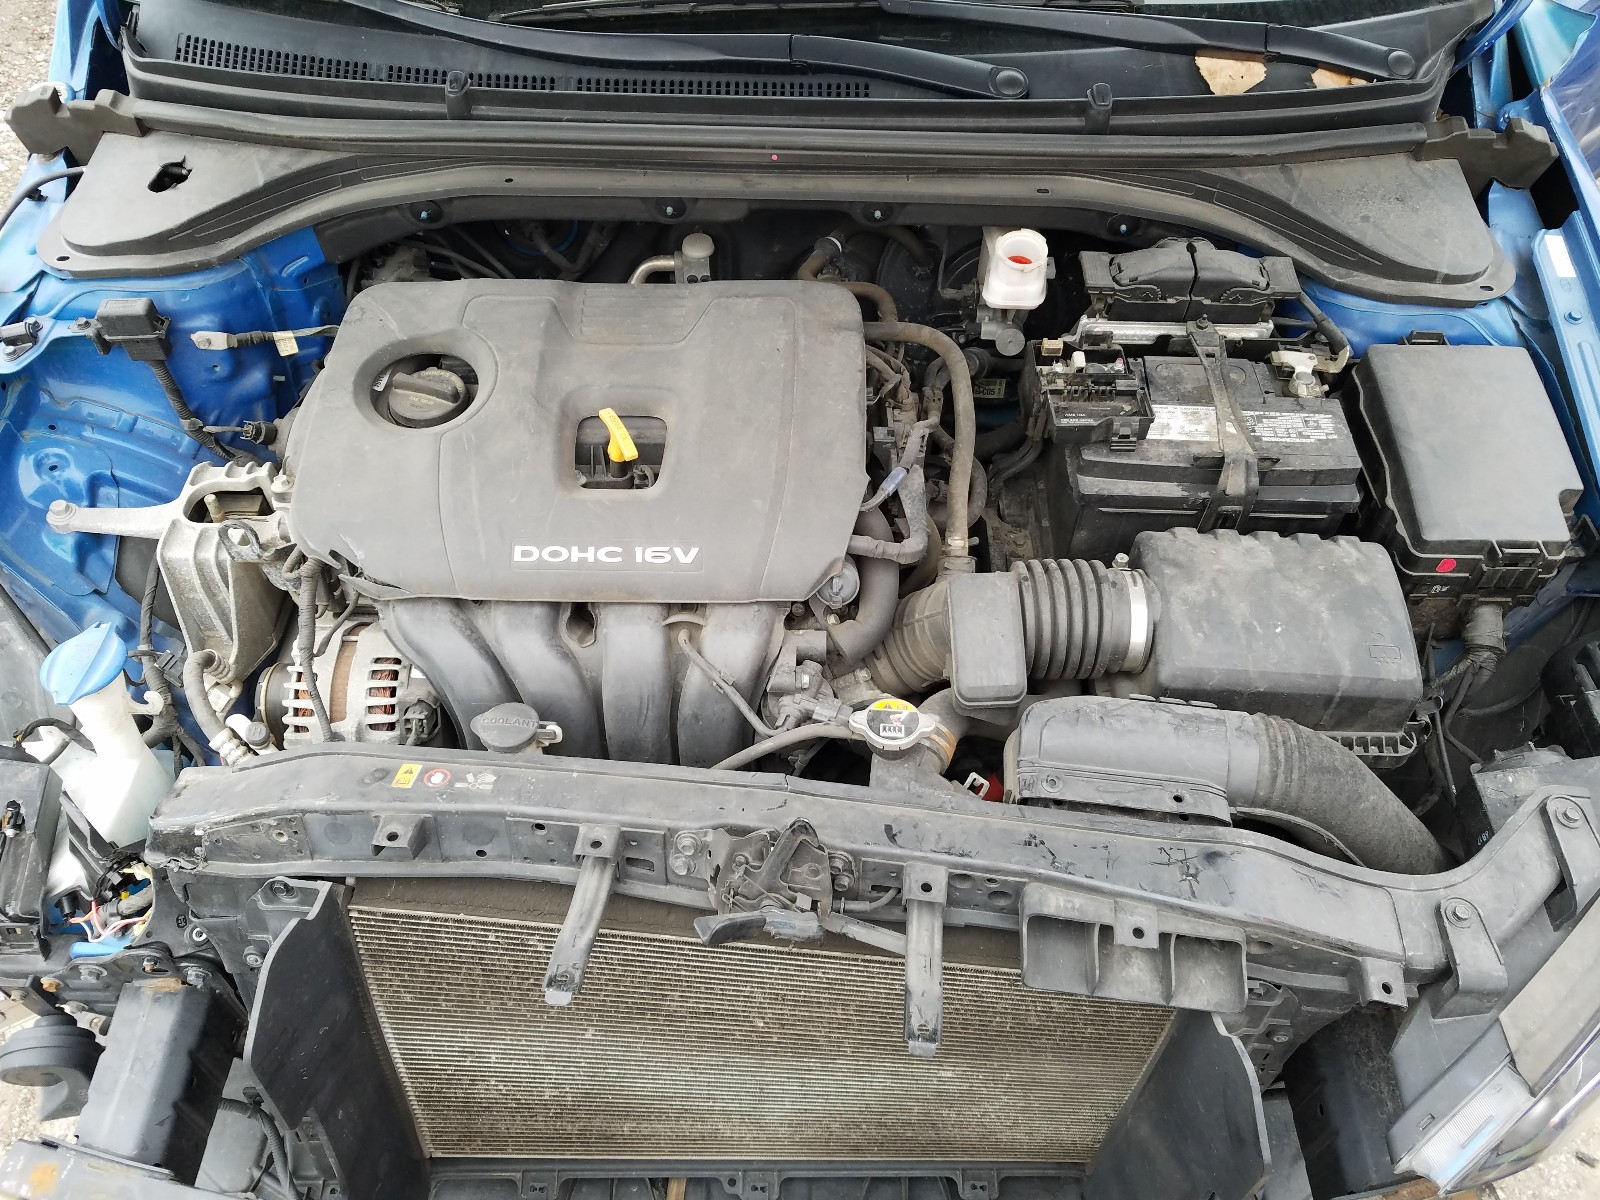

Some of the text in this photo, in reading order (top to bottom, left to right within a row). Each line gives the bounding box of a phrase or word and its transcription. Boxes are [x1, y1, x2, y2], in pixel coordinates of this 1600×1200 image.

[513, 545, 700, 564] DOHC 16V
[482, 717, 539, 729] COOLANT
